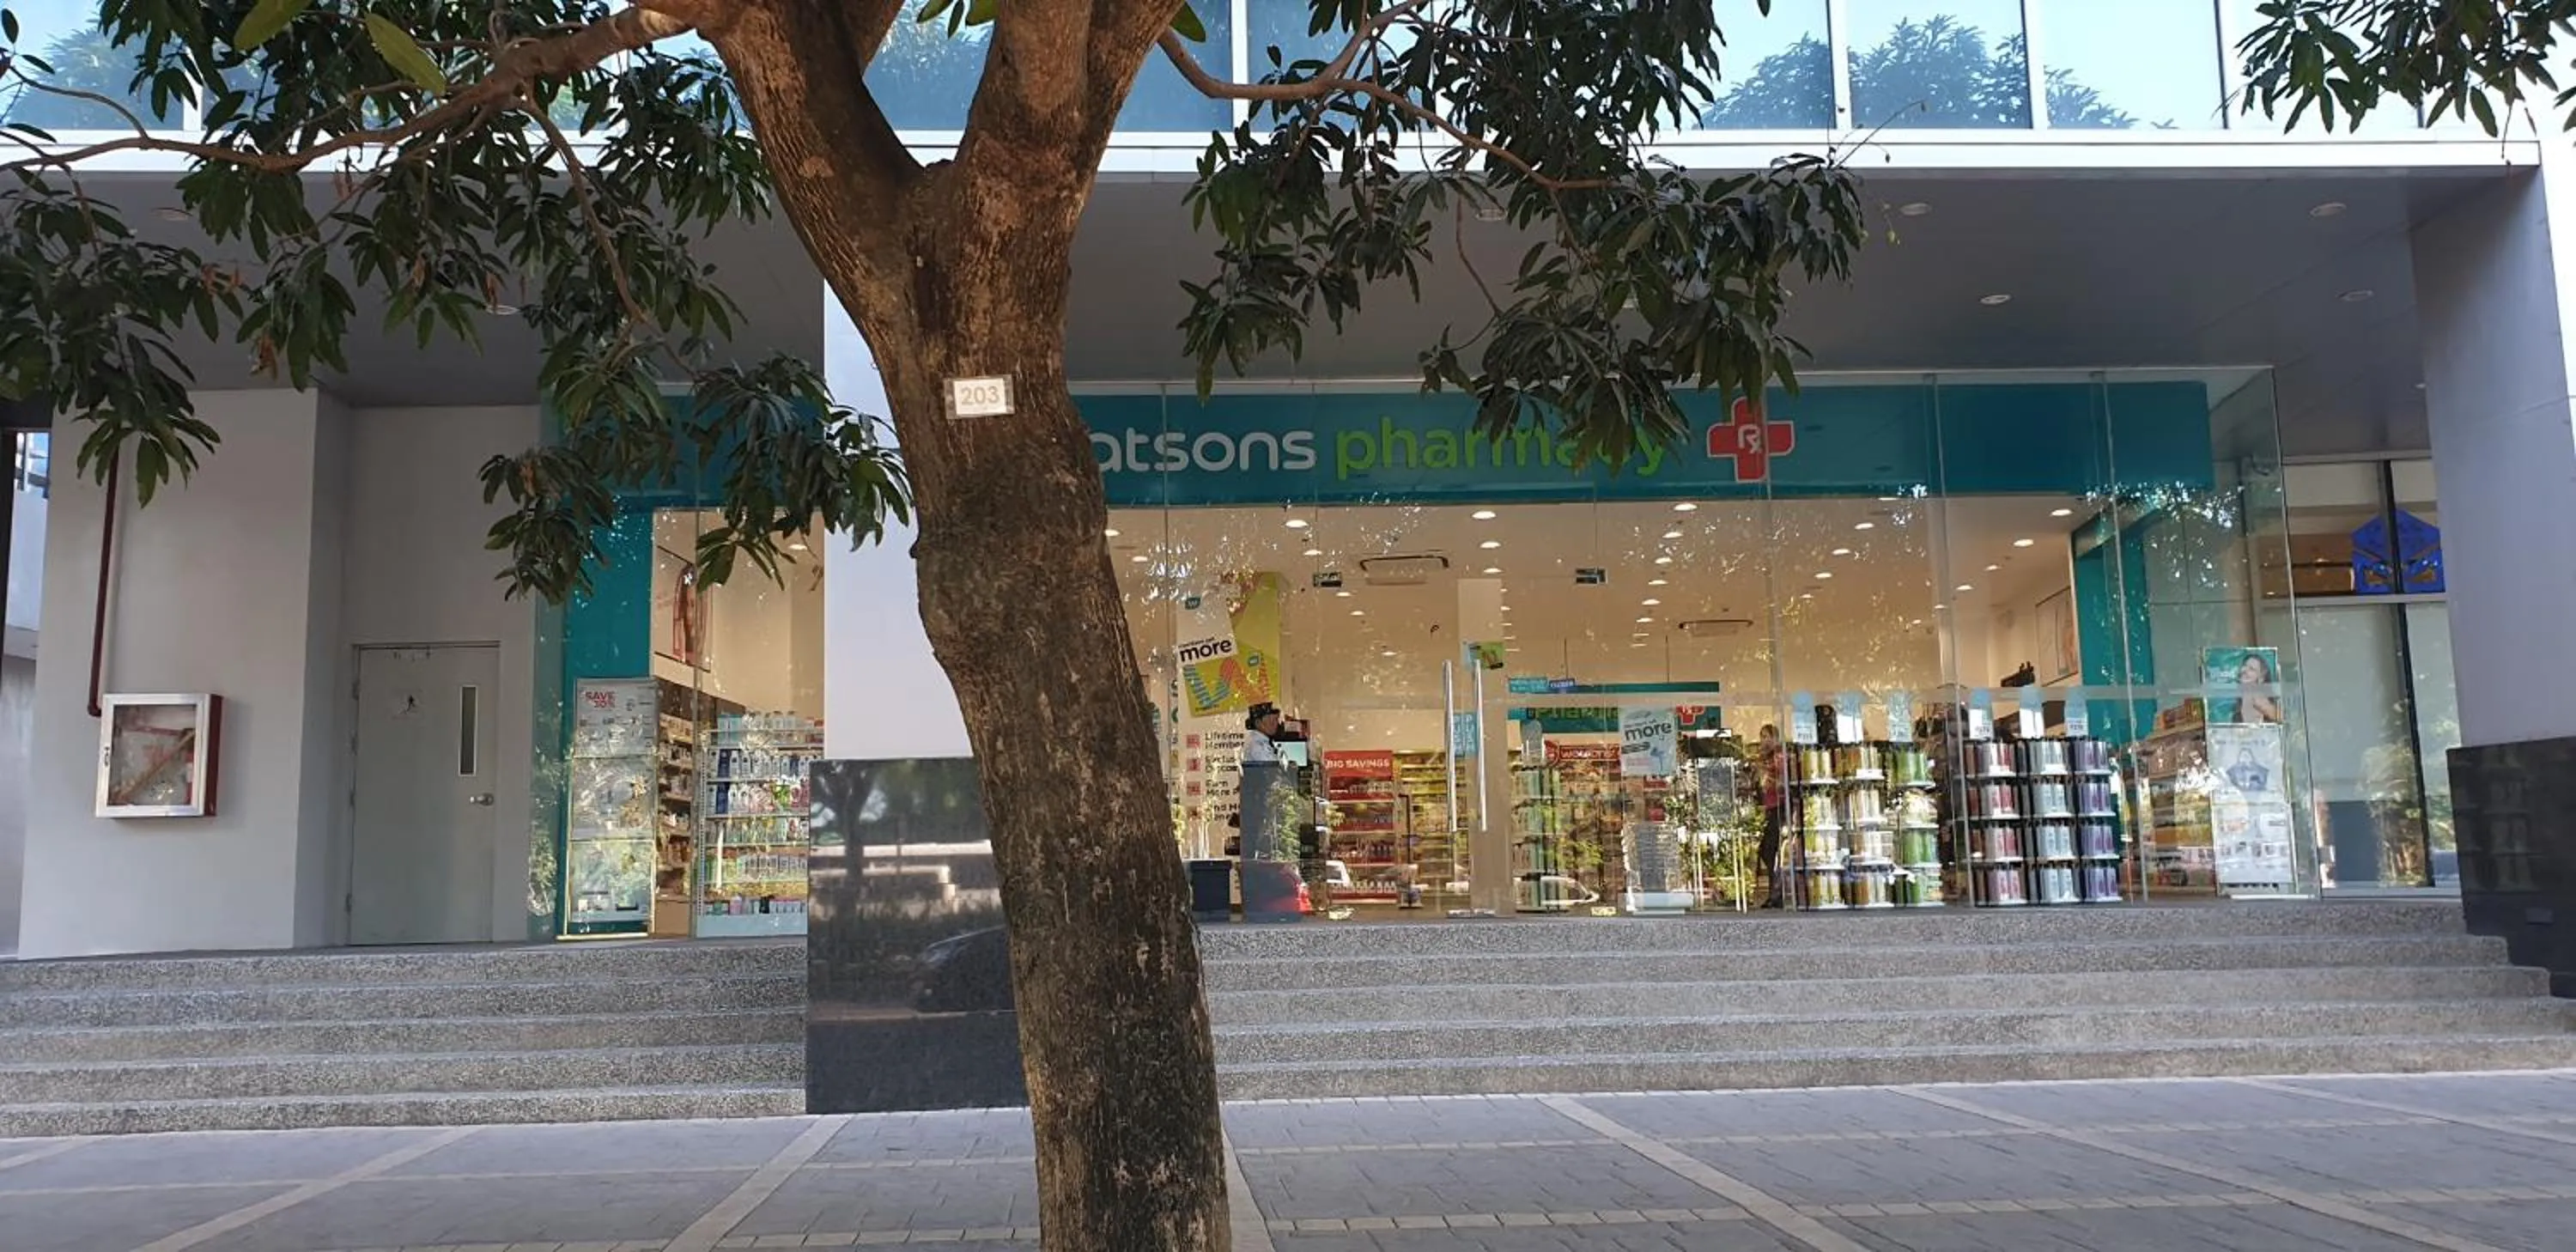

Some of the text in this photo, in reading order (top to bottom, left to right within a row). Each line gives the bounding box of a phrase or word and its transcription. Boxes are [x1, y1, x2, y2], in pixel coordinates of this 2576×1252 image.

[960, 386, 1000, 406] 203
[1088, 427, 1318, 472] atsons
[1180, 640, 1232, 662] more
[1625, 722, 1672, 741] more
[1346, 758, 1390, 769] SAVINGS
